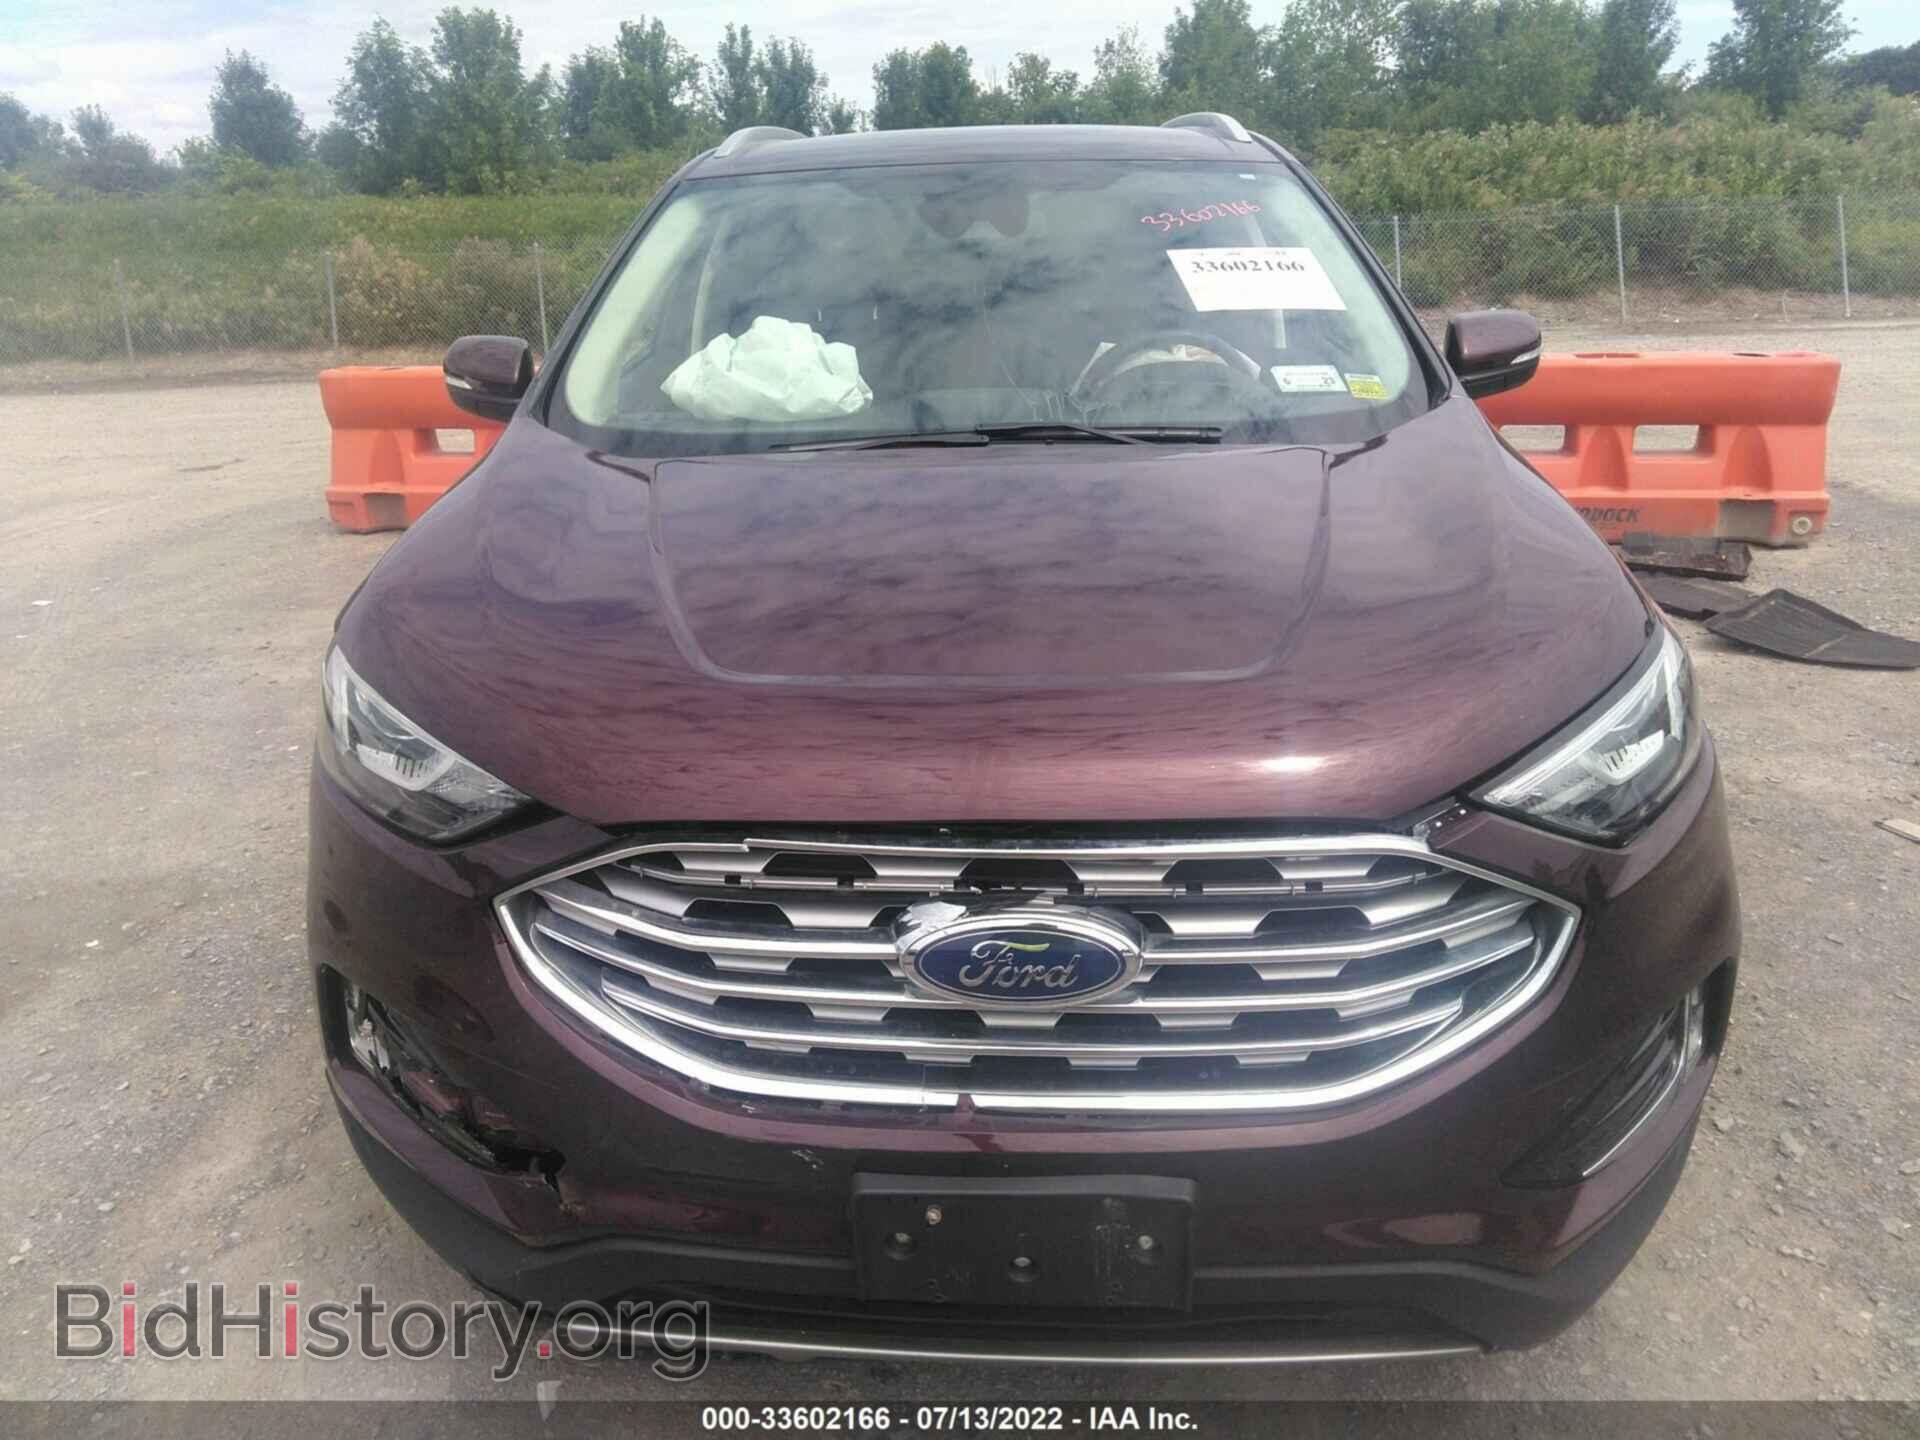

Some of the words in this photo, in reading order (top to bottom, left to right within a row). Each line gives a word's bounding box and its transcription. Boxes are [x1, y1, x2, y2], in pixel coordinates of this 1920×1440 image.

[1141, 200, 1261, 231] 33602166
[1193, 260, 1305, 273] 33602166
[958, 940, 1082, 988] Ford
